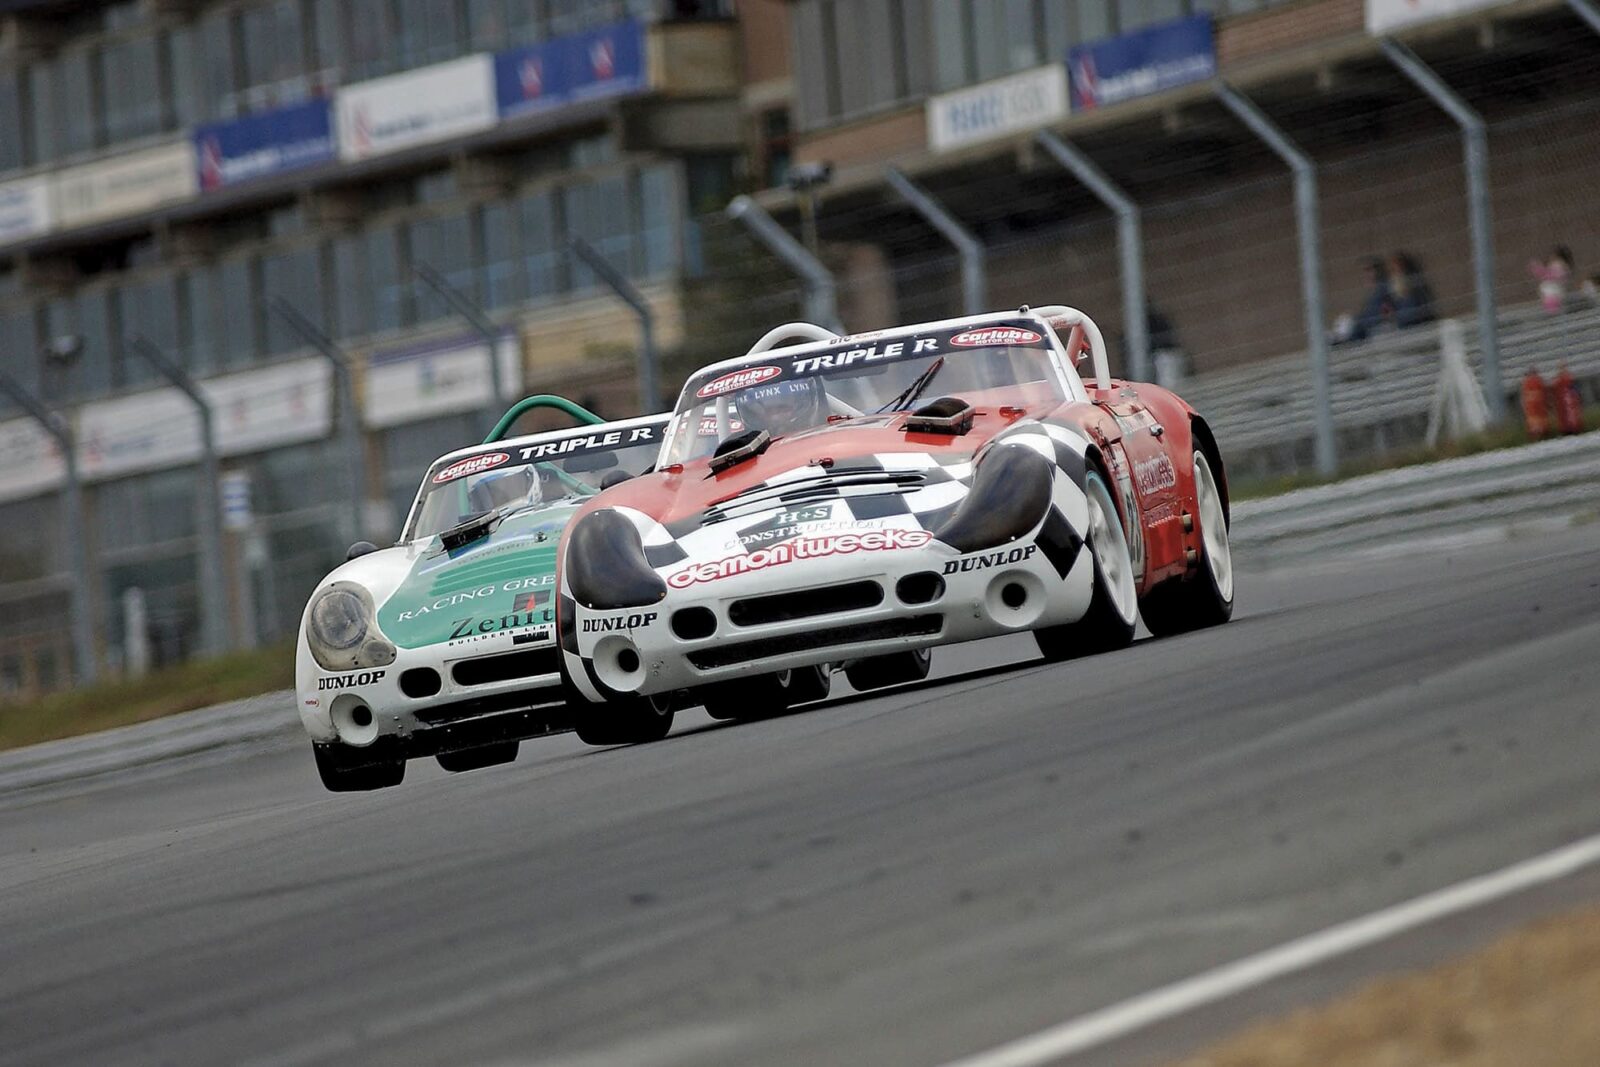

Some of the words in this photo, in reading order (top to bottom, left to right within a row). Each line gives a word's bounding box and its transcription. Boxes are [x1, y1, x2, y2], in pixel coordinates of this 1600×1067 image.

[792, 342, 904, 373] TRIPLE
[913, 338, 940, 353] R
[754, 386, 781, 400] LYNX
[519, 431, 621, 460] TRIPLE
[629, 427, 654, 441] R
[775, 507, 830, 525] H+S
[667, 543, 792, 589] demon
[792, 528, 934, 559] tweeks
[942, 545, 1037, 575] DUNLOP
[397, 585, 495, 622] RACING
[503, 574, 556, 592] GRE
[448, 630, 514, 647] BUILDERS
[524, 623, 554, 633] LIMI
[449, 606, 554, 640] Zenit
[582, 612, 658, 632] DUNLOP
[318, 670, 386, 691] DUNLOP
